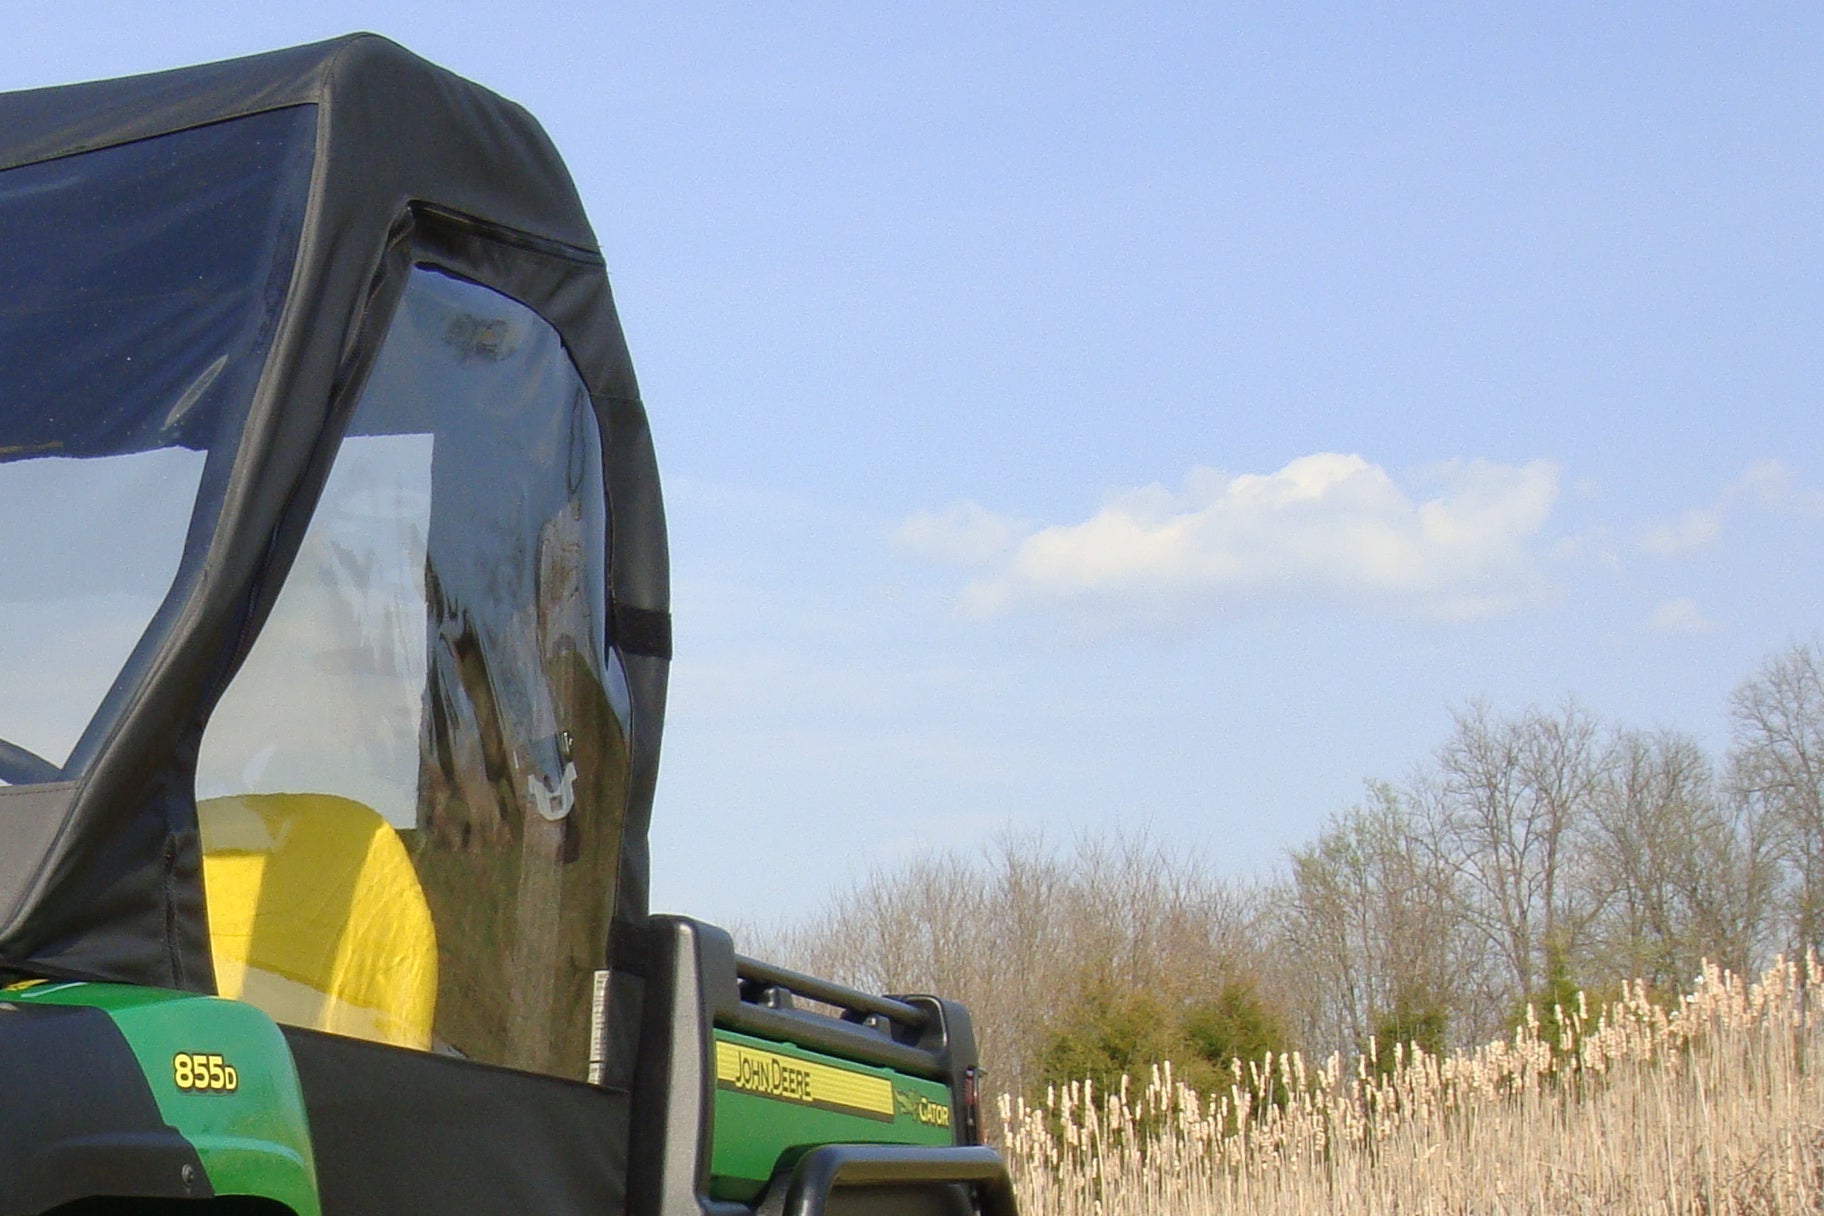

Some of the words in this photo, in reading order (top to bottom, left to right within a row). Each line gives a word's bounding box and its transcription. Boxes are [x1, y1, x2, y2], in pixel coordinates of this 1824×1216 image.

[174, 1052, 238, 1091] 855D
[736, 1050, 770, 1092] JOHN
[771, 1058, 812, 1100] DEERE
[918, 1096, 950, 1127] GATOR
